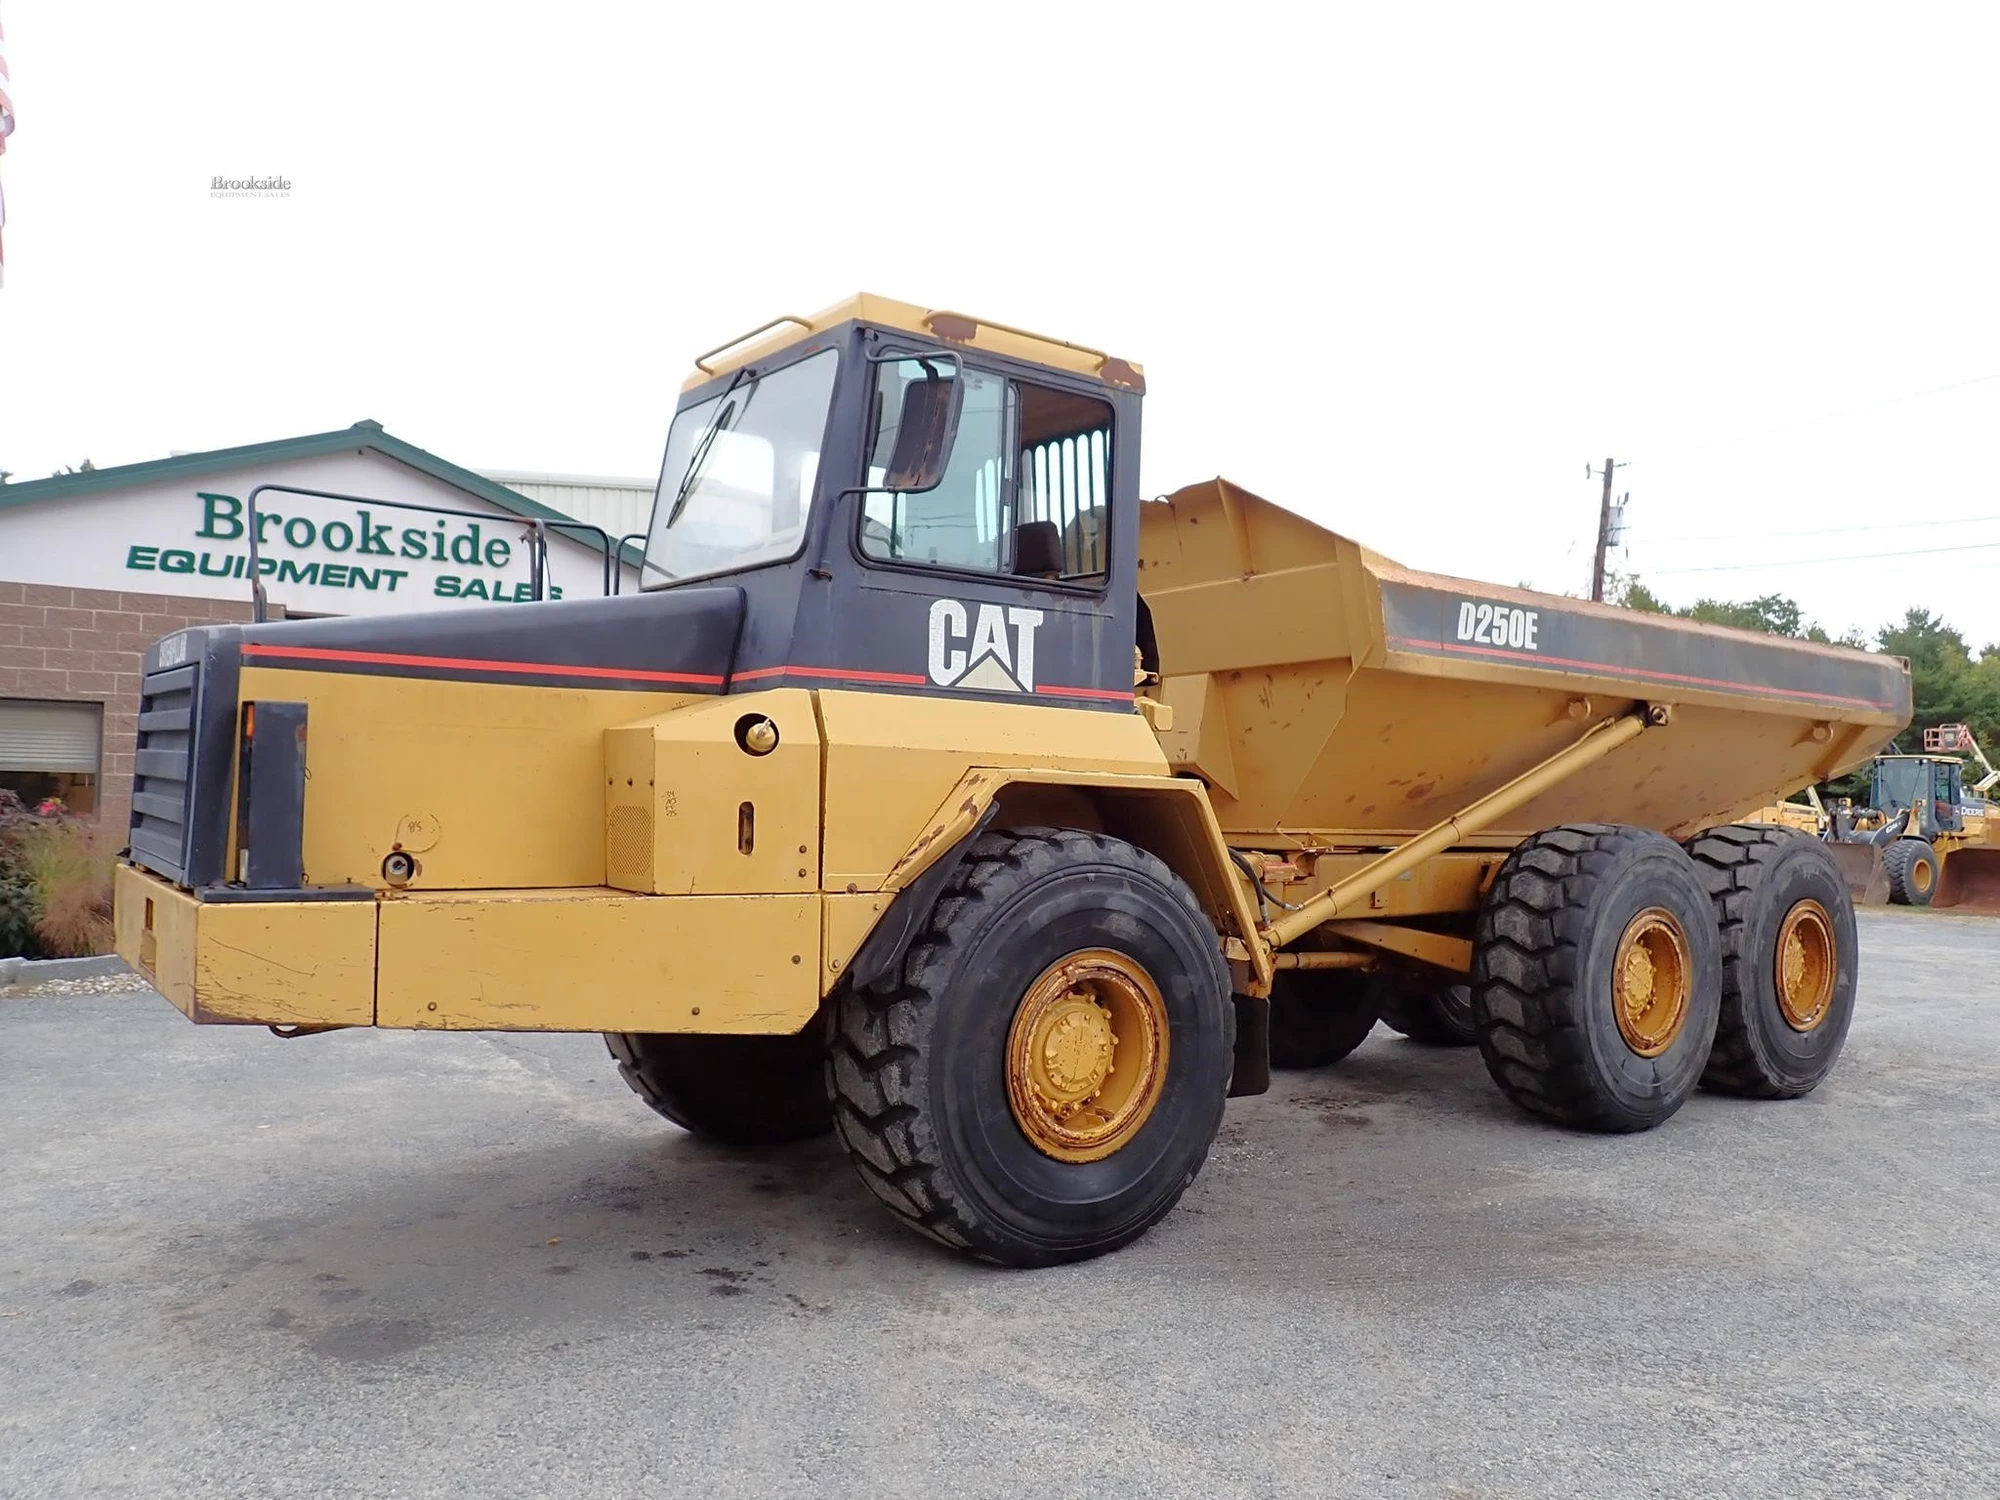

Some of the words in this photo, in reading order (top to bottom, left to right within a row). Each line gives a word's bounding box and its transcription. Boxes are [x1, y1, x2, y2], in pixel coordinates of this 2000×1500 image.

[195, 493, 511, 567] Brookside
[126, 545, 408, 591] EQUIPMENT
[928, 599, 1044, 692] CAT
[1457, 601, 1538, 649] D250E
